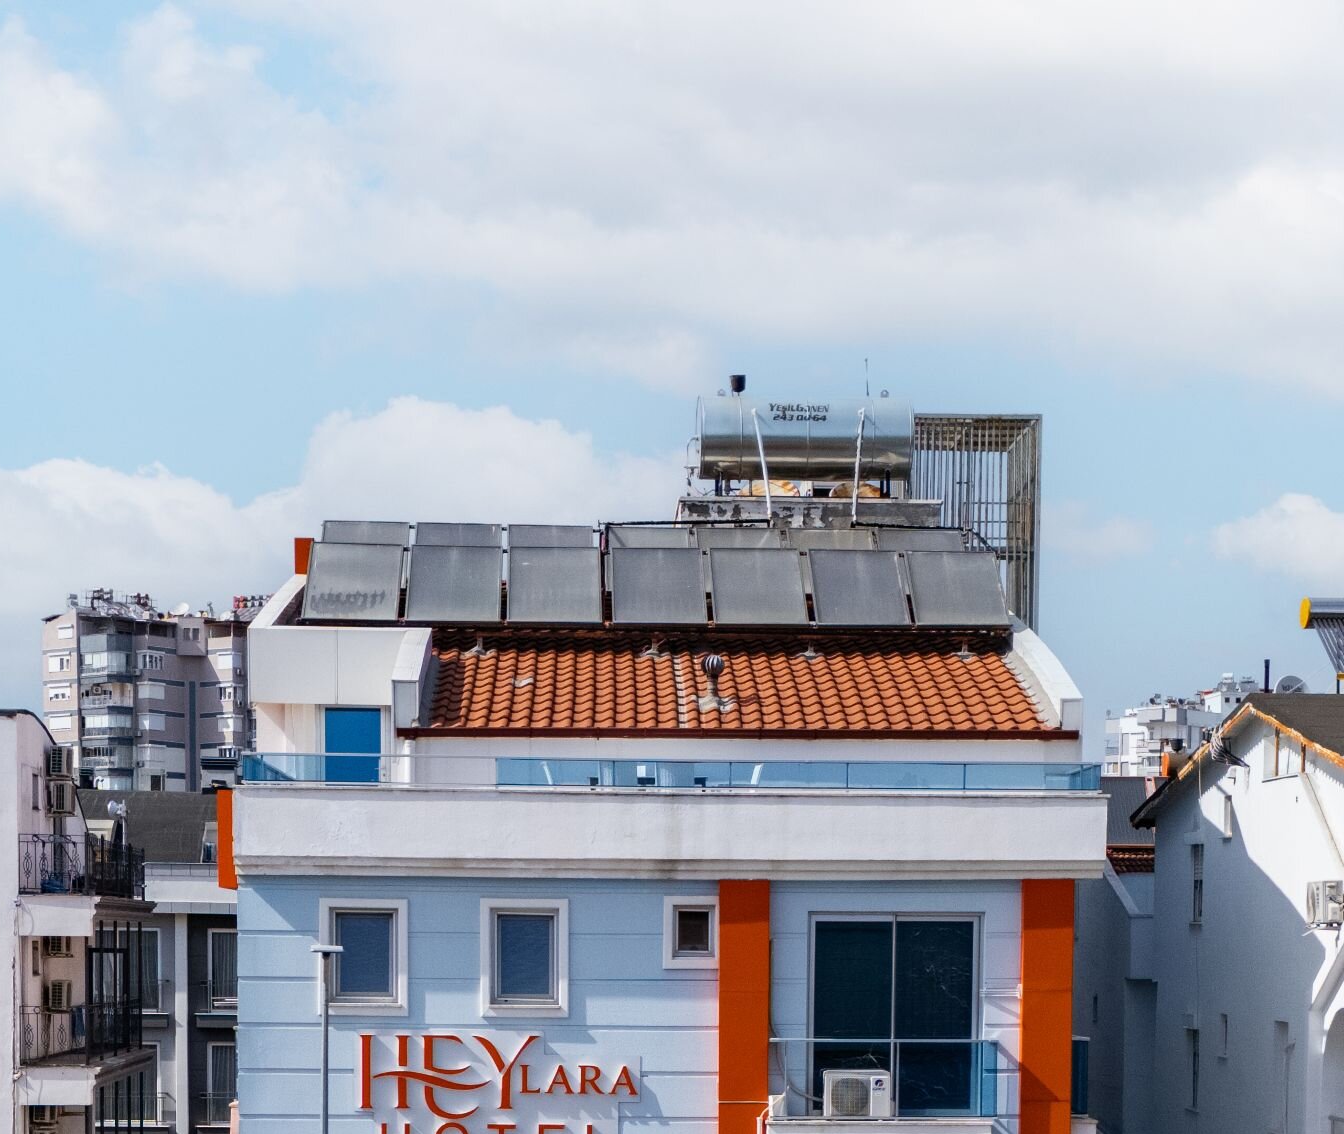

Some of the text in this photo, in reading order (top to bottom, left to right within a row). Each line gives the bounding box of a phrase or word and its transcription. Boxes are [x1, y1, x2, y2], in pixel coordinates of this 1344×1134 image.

[773, 413, 794, 421] 243
[359, 1034, 638, 1119] HEY LARA
